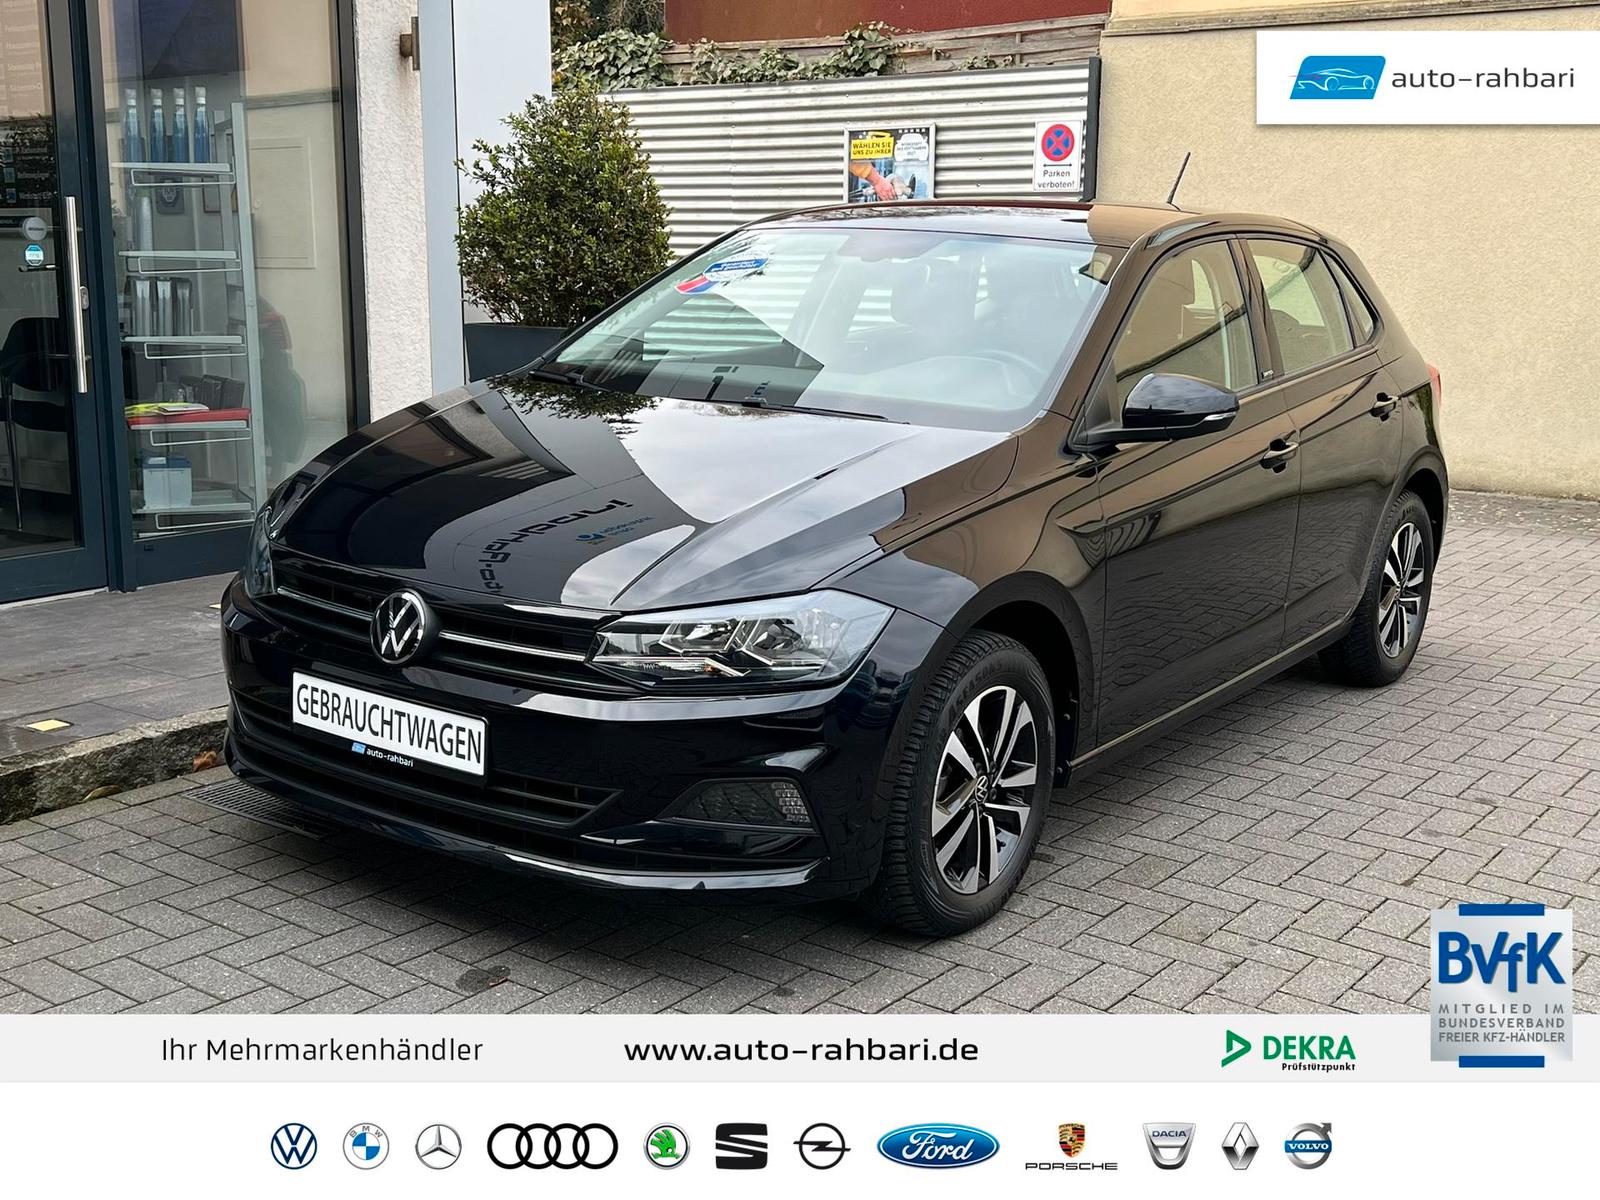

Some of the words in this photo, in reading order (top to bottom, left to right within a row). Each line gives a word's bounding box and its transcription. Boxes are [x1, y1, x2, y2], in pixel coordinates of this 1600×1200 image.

[1043, 169, 1071, 178] Parken
[1037, 180, 1075, 189] verboten!
[296, 683, 482, 765] GEBRAUCHTWAGEN
[366, 746, 414, 768] auto-rahbari
